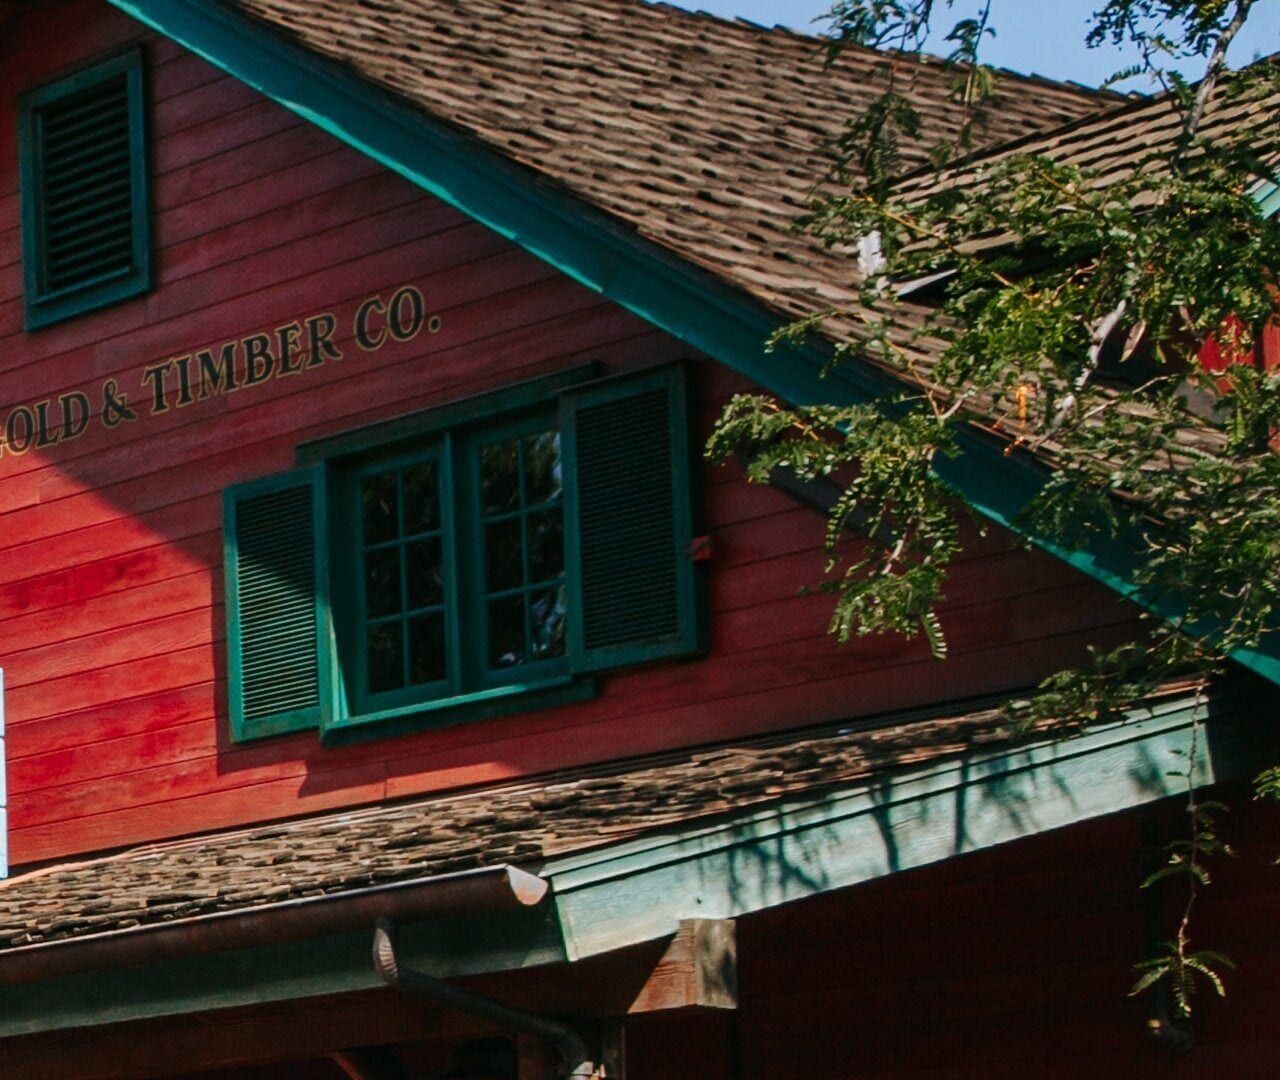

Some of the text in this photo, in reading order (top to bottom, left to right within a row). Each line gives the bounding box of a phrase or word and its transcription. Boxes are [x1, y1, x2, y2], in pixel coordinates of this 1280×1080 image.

[100, 378, 136, 428] &
[142, 312, 344, 418] TIMBER
[353, 285, 443, 352] CO.
